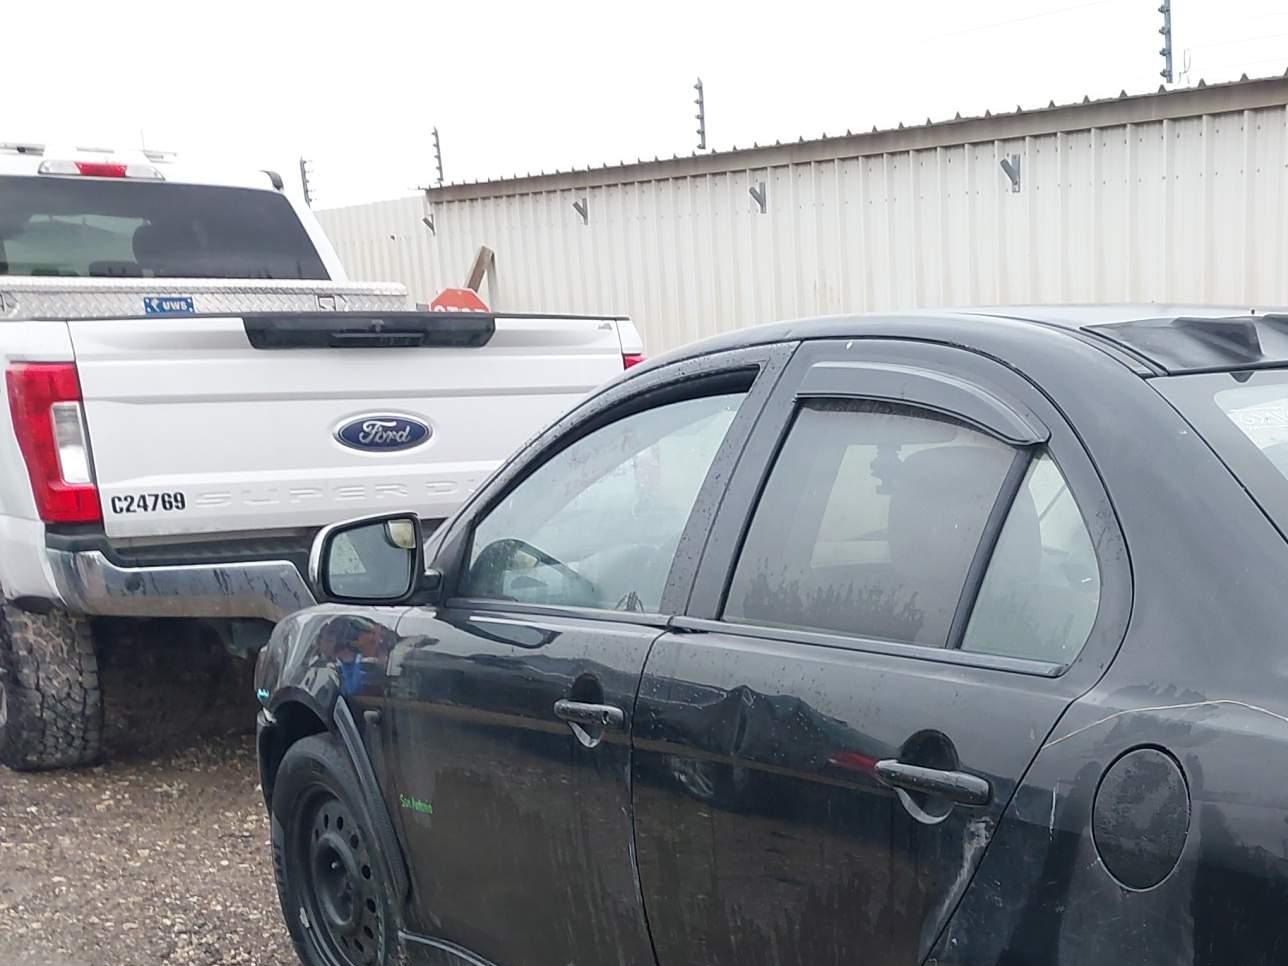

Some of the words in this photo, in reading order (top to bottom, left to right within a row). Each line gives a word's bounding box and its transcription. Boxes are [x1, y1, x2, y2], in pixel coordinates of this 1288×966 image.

[359, 420, 411, 443] Ford
[110, 491, 186, 515] C24769
[196, 482, 408, 508] SUPER
